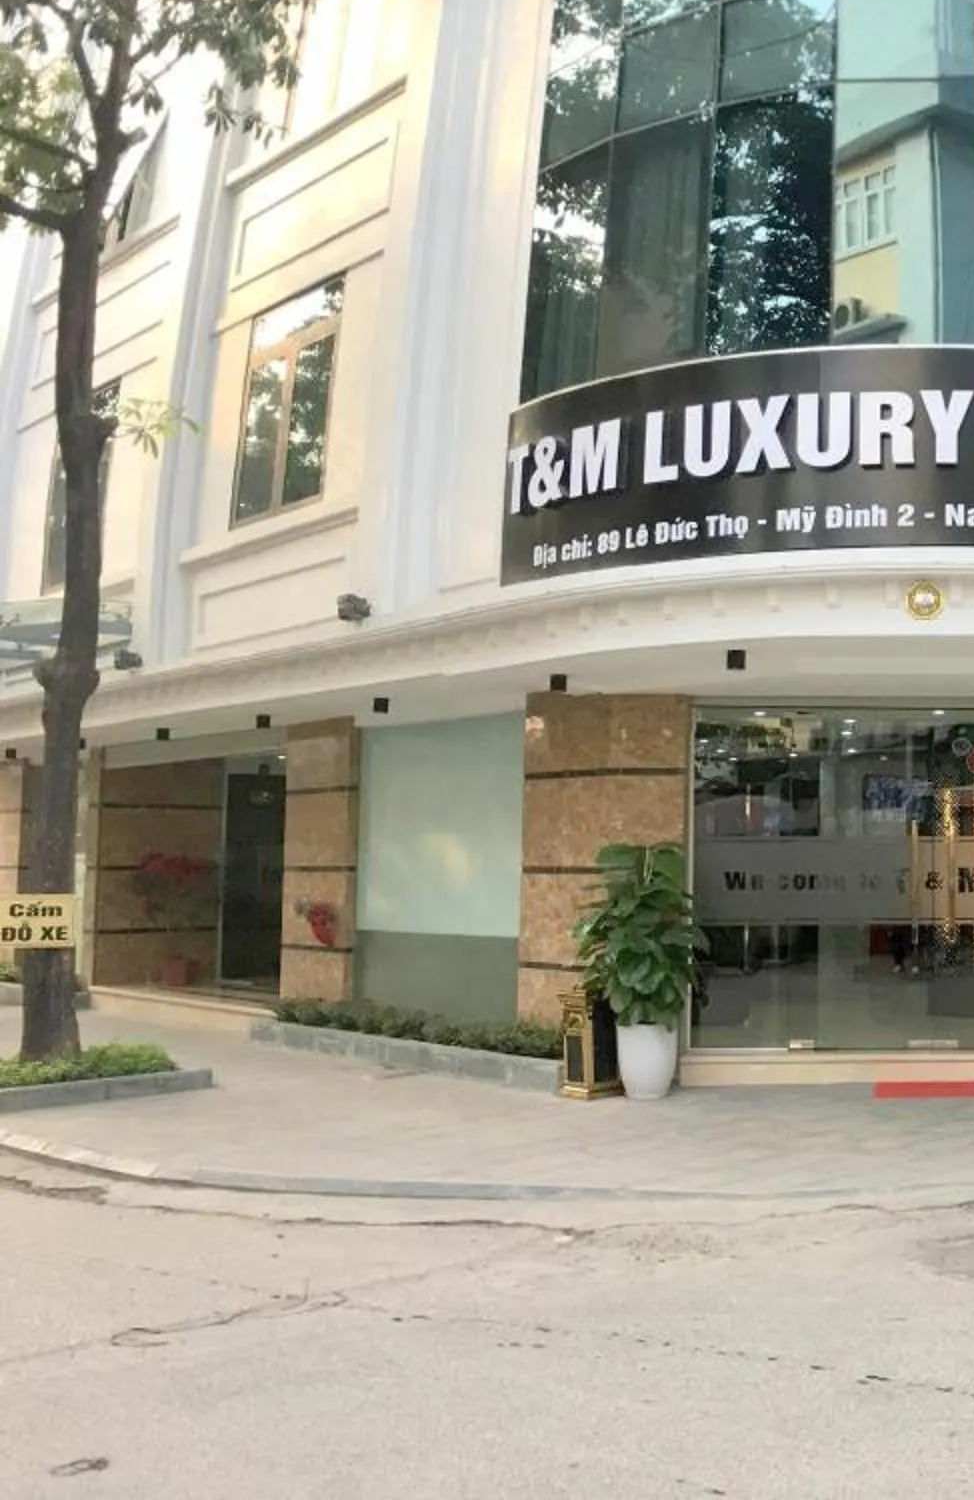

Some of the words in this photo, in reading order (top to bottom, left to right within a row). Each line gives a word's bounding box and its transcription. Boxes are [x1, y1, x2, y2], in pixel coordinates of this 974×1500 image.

[508, 417, 622, 515] T&M
[643, 389, 974, 485] LUXURY
[597, 529, 621, 554] 89
[625, 523, 648, 549] Lê
[654, 516, 698, 544] Đức
[705, 513, 748, 539] Thọ
[776, 505, 817, 533] Mỹ
[825, 503, 887, 529] Đình
[897, 503, 915, 527] 2
[41, 925, 69, 941] XE
